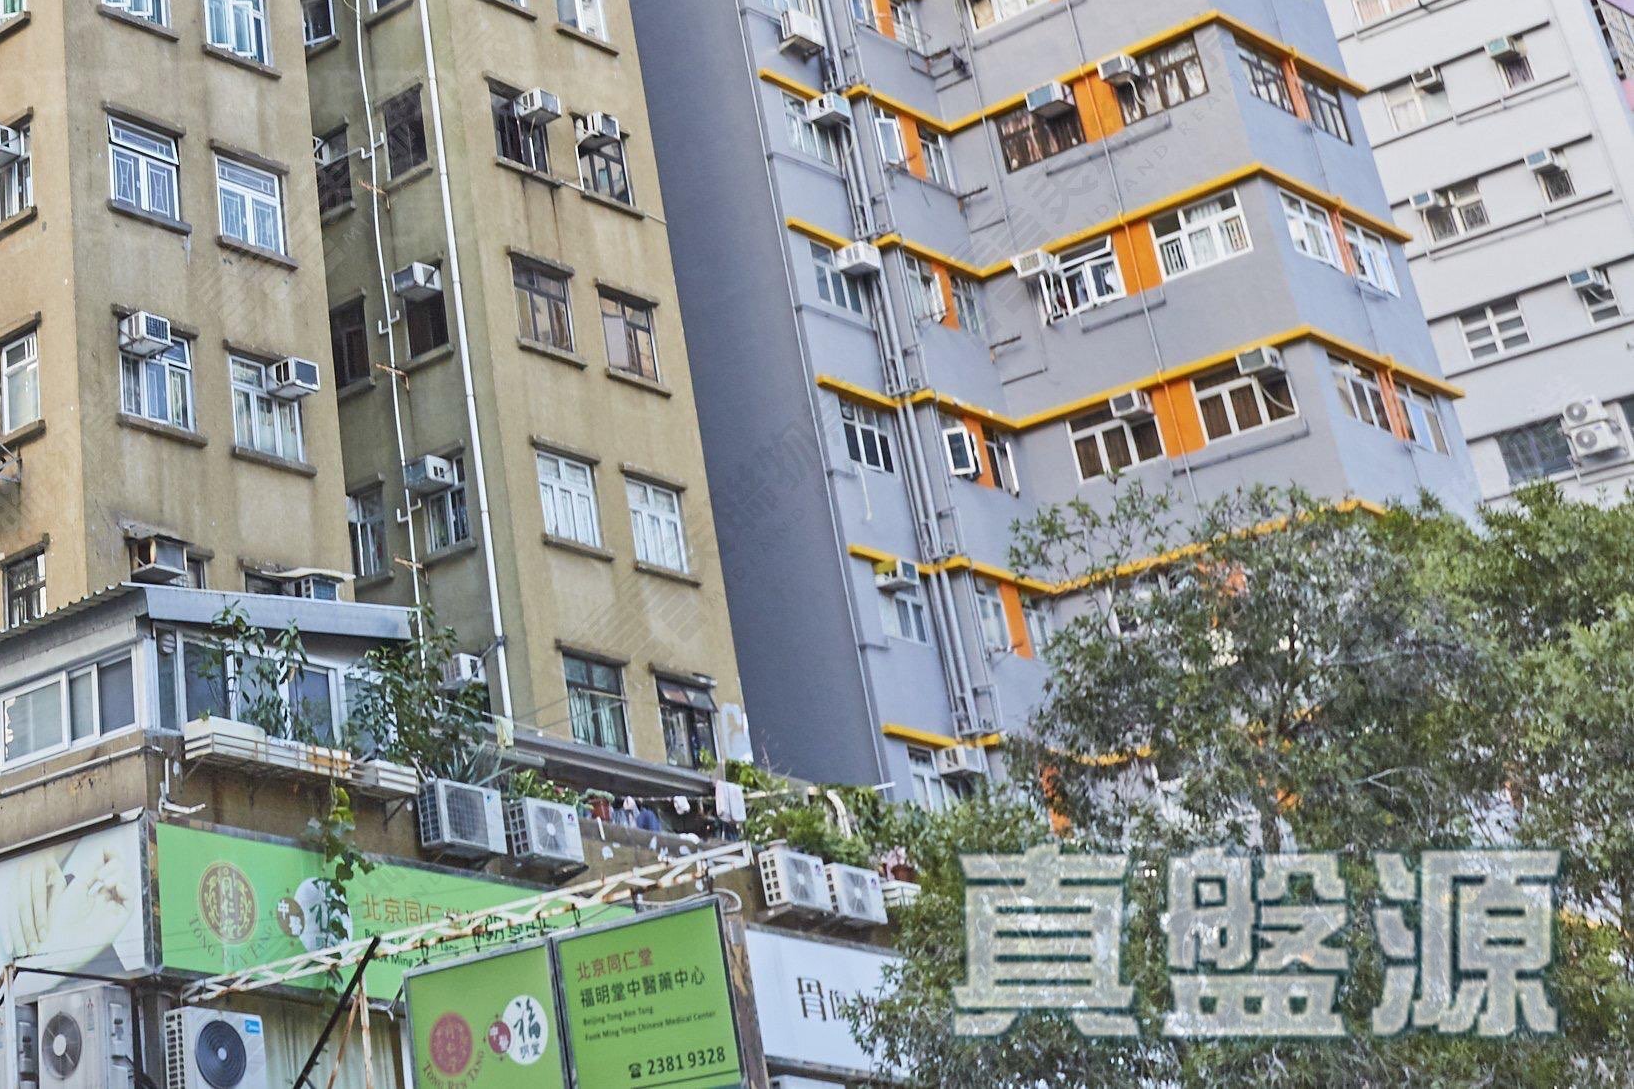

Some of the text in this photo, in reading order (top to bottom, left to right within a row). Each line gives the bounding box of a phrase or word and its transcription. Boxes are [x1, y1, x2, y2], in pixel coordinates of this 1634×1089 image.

[576, 947, 654, 983] 北京同仁堂
[580, 965, 706, 1008] 福明堂中醫藥中心
[602, 1028, 620, 1039] Ming
[638, 1020, 664, 1032] Chinese
[665, 1014, 692, 1027] Medical
[647, 1046, 726, 1076] 2381 9328
